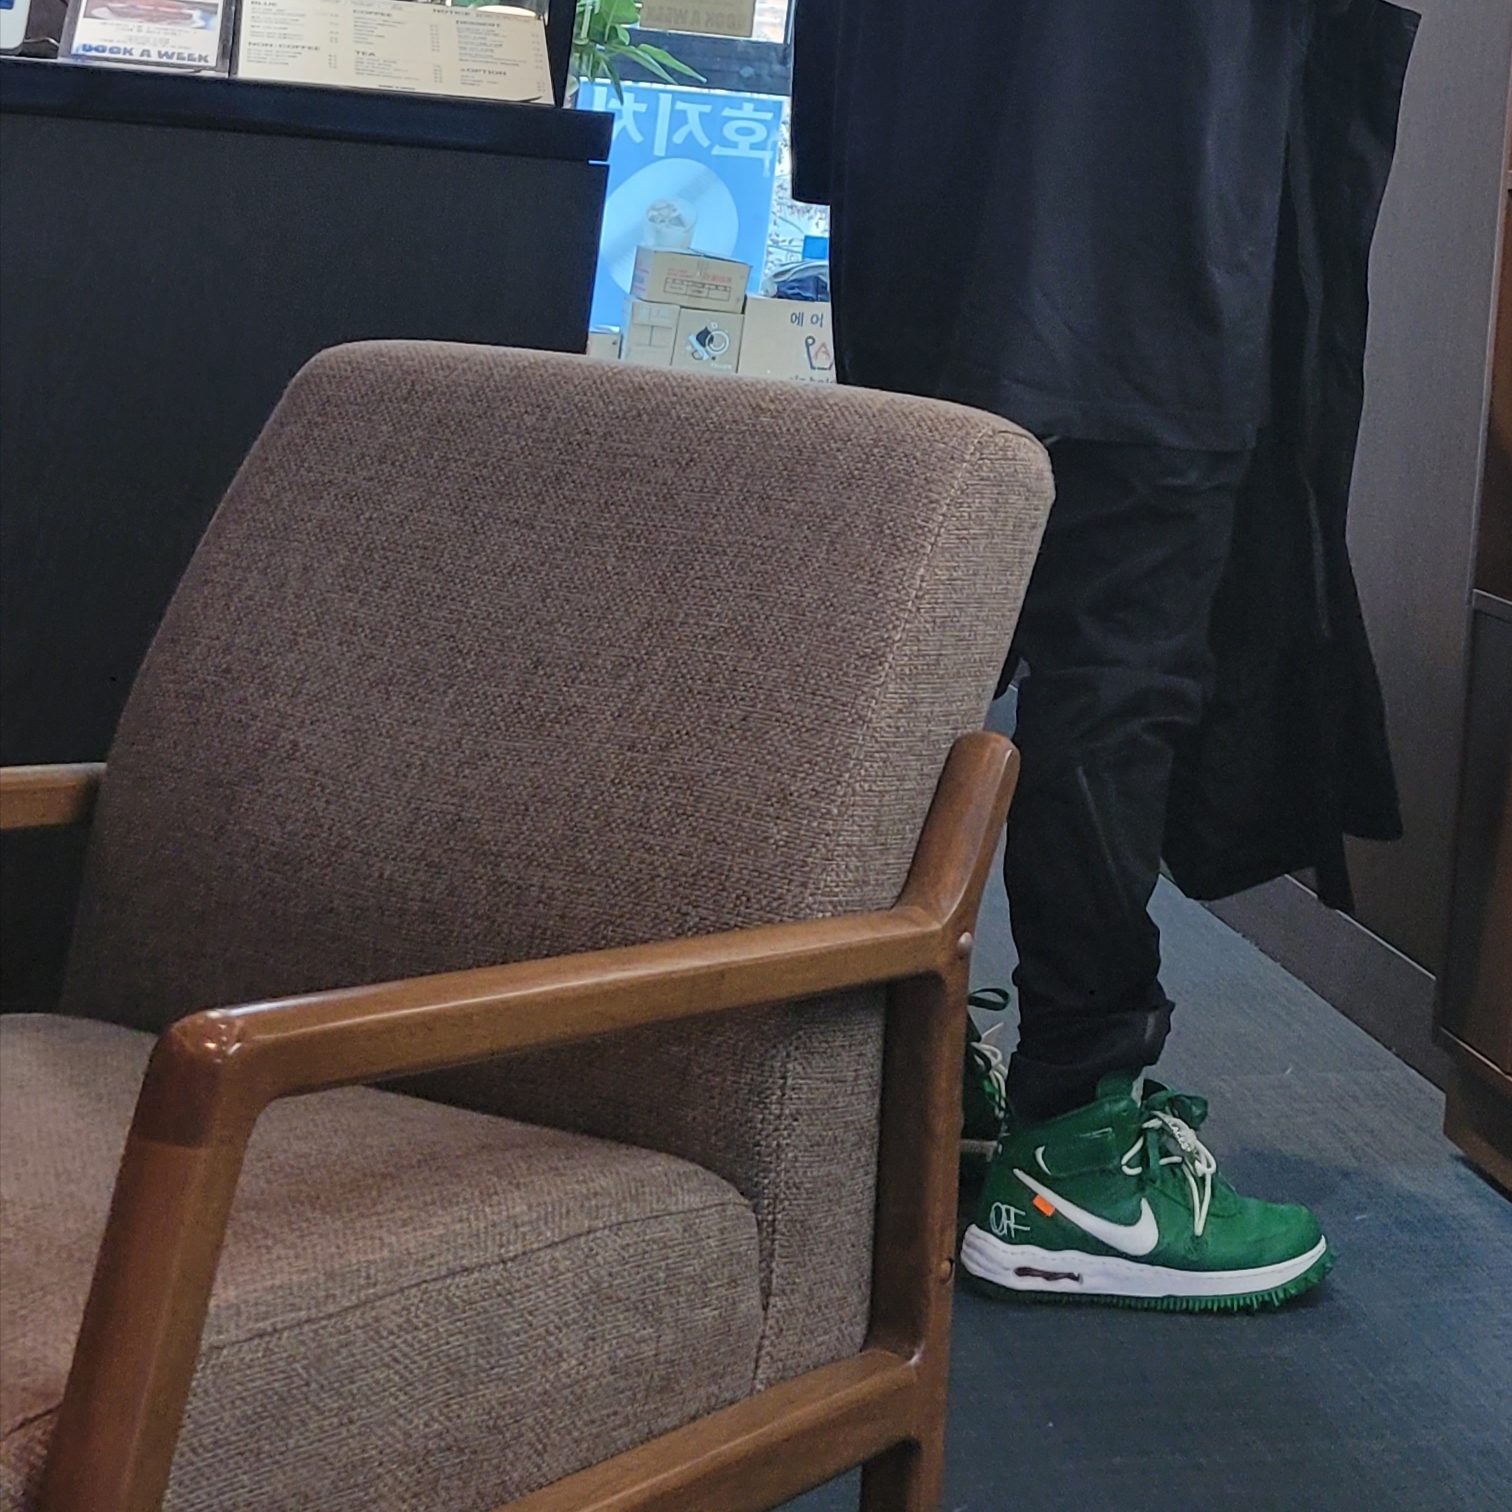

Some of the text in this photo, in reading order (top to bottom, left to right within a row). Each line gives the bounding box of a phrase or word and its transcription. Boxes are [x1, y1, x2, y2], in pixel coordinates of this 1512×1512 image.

[81, 42, 210, 64] BOOK A WEEK
[355, 49, 376, 57] TEA
